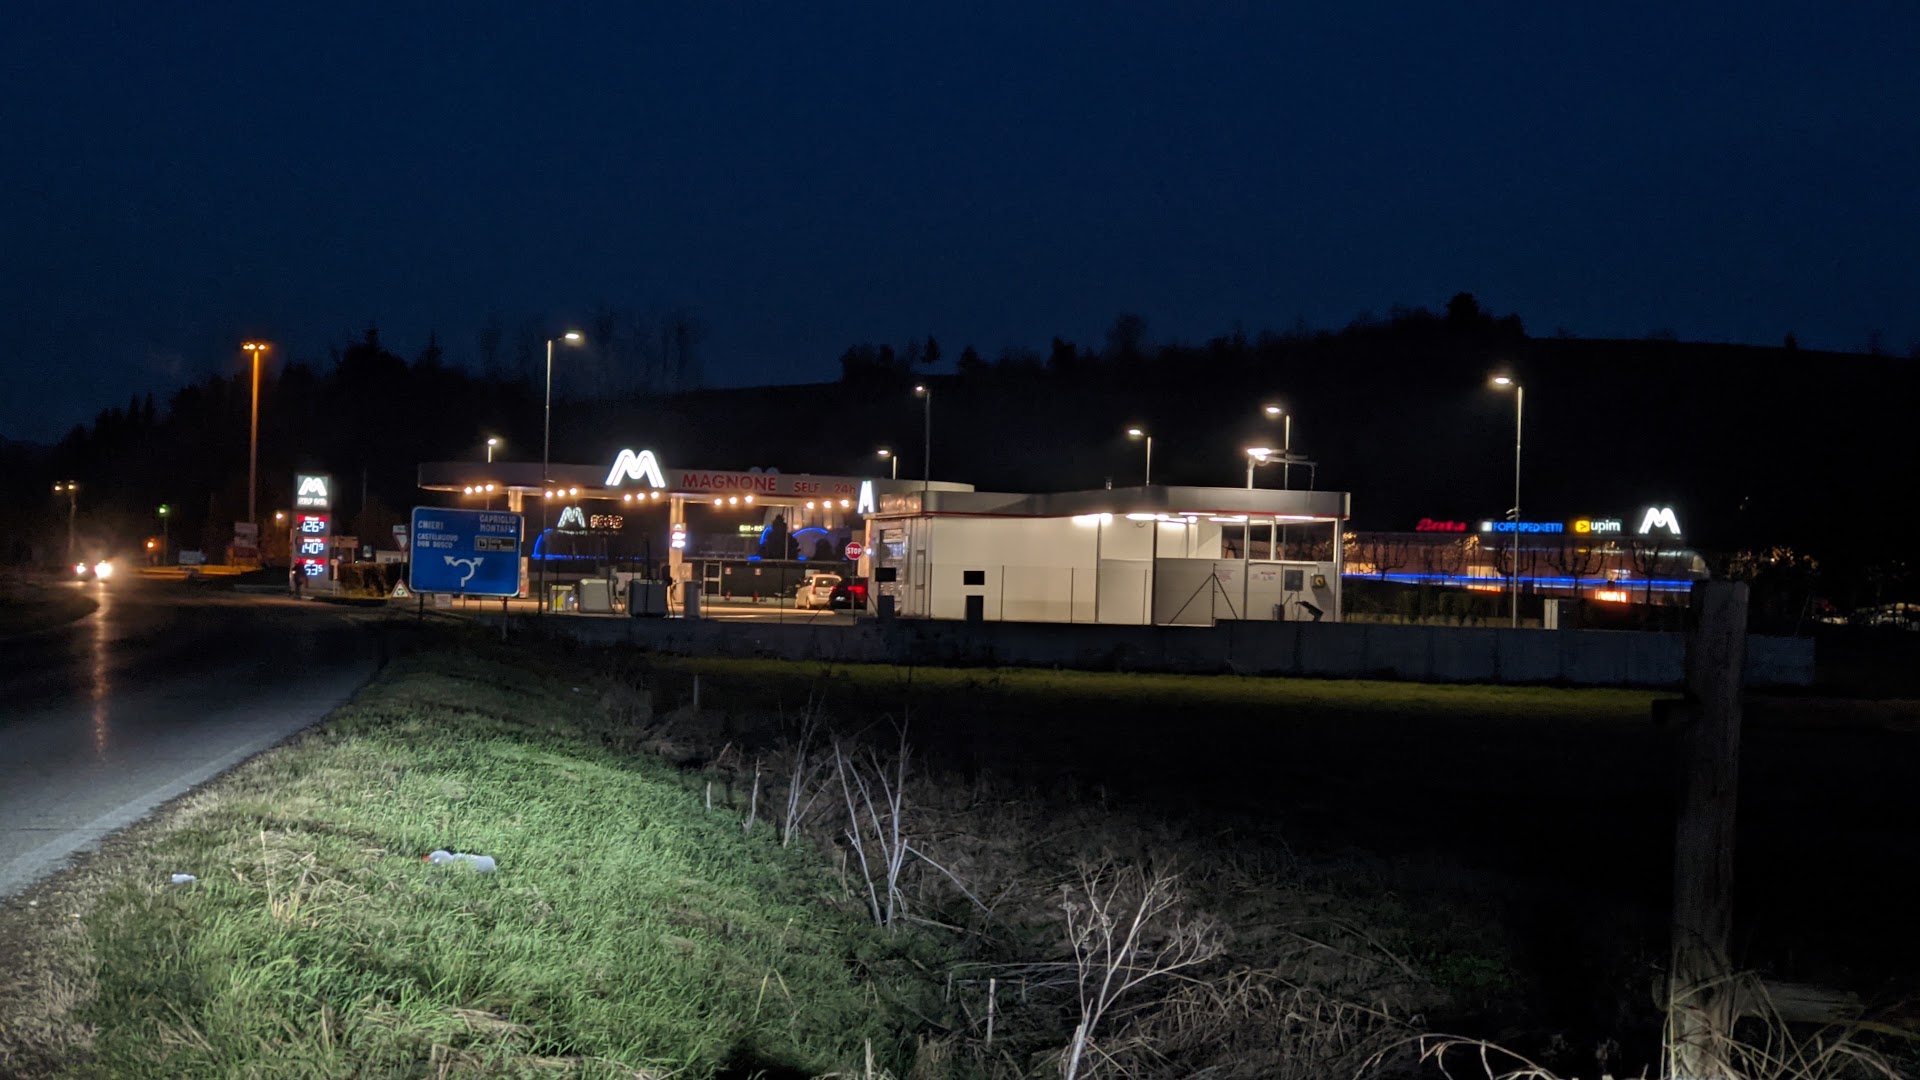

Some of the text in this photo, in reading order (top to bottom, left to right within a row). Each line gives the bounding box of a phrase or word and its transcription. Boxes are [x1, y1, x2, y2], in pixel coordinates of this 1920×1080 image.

[682, 474, 856, 495] MAGNONE SELF 24h
[417, 520, 444, 530] CHIERI
[1590, 520, 1620, 532] upim
